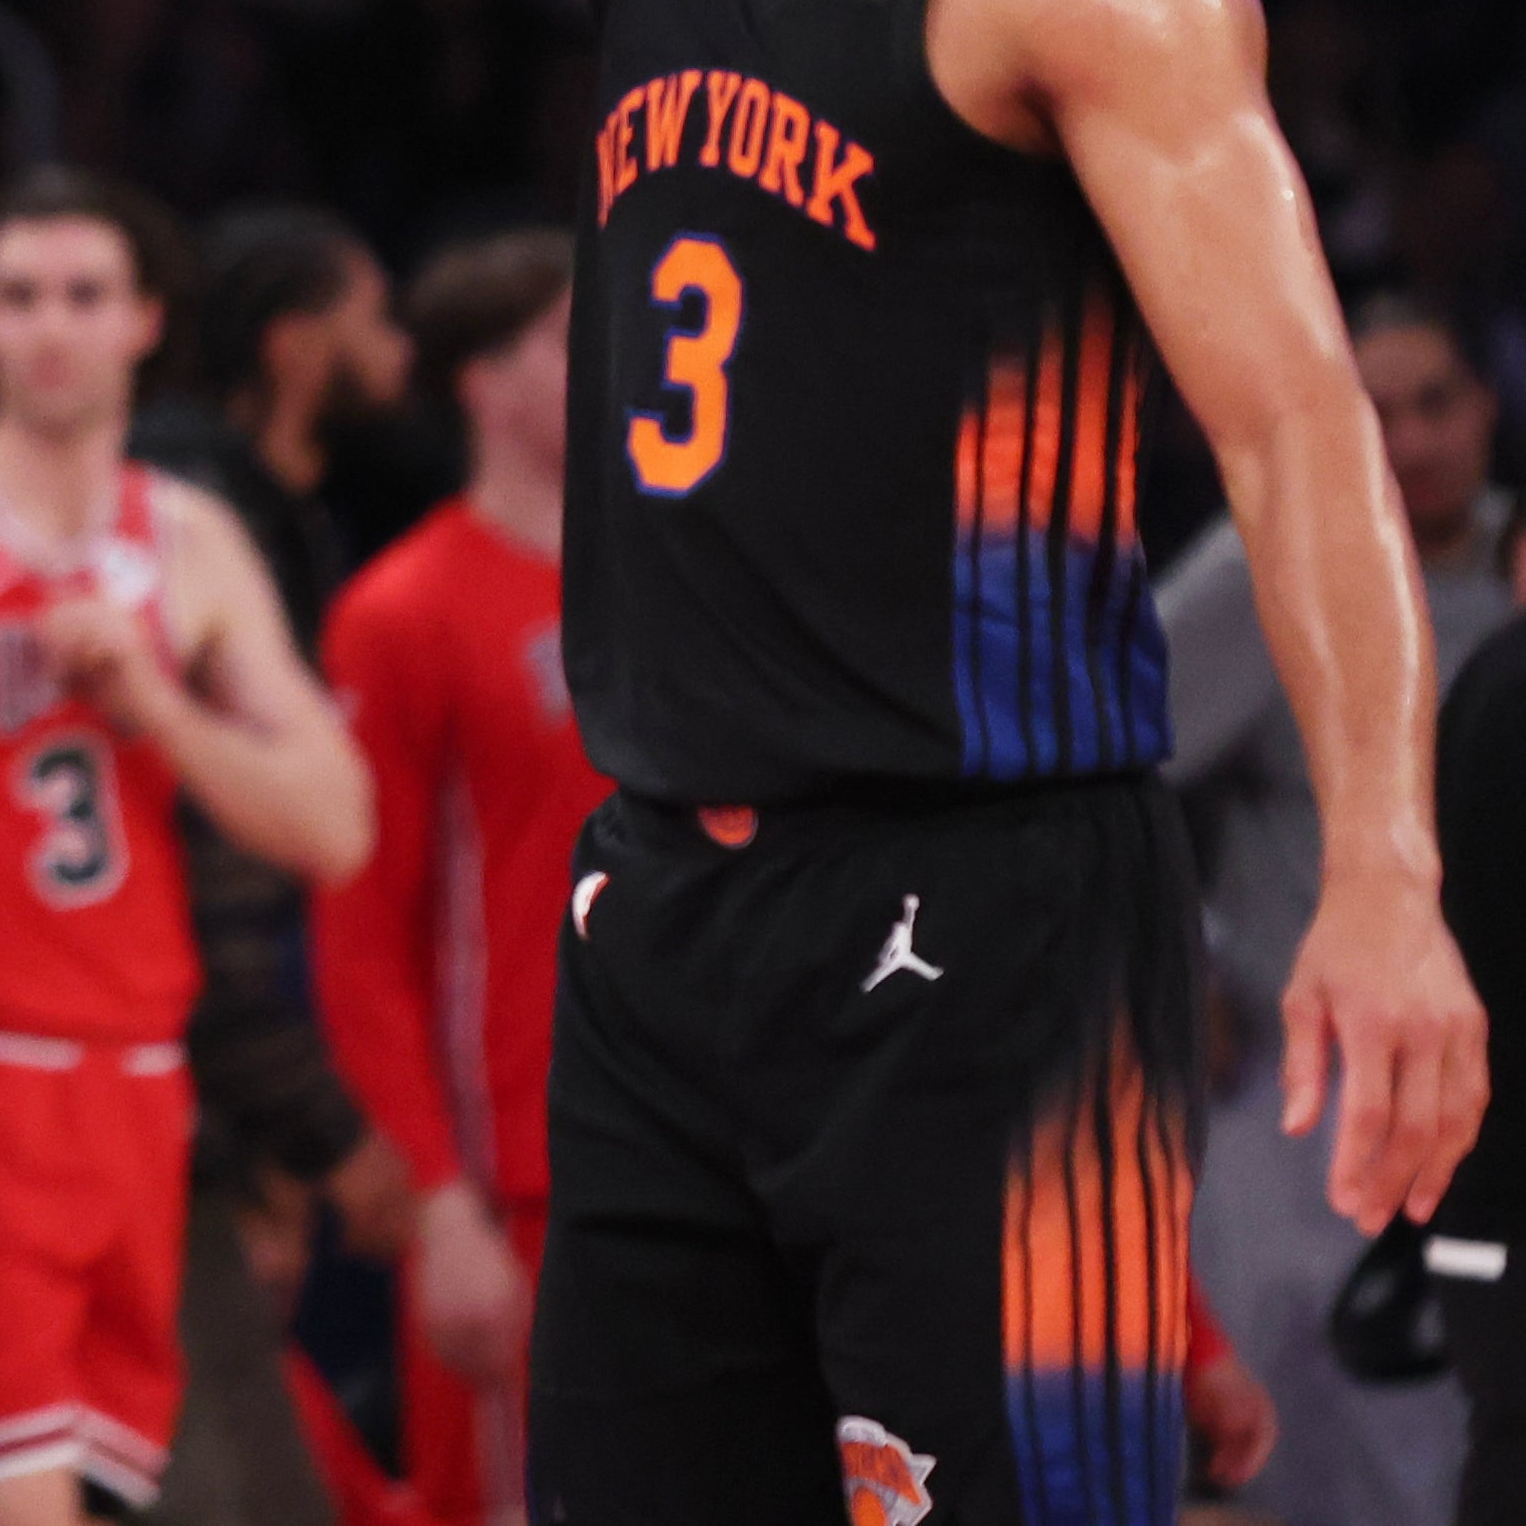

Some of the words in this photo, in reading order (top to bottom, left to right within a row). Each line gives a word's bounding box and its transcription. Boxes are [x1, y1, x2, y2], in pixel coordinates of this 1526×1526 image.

[595, 69, 703, 229] NEW
[700, 69, 876, 252] YORK
[627, 231, 742, 499] 3
[9, 730, 131, 911] 3
